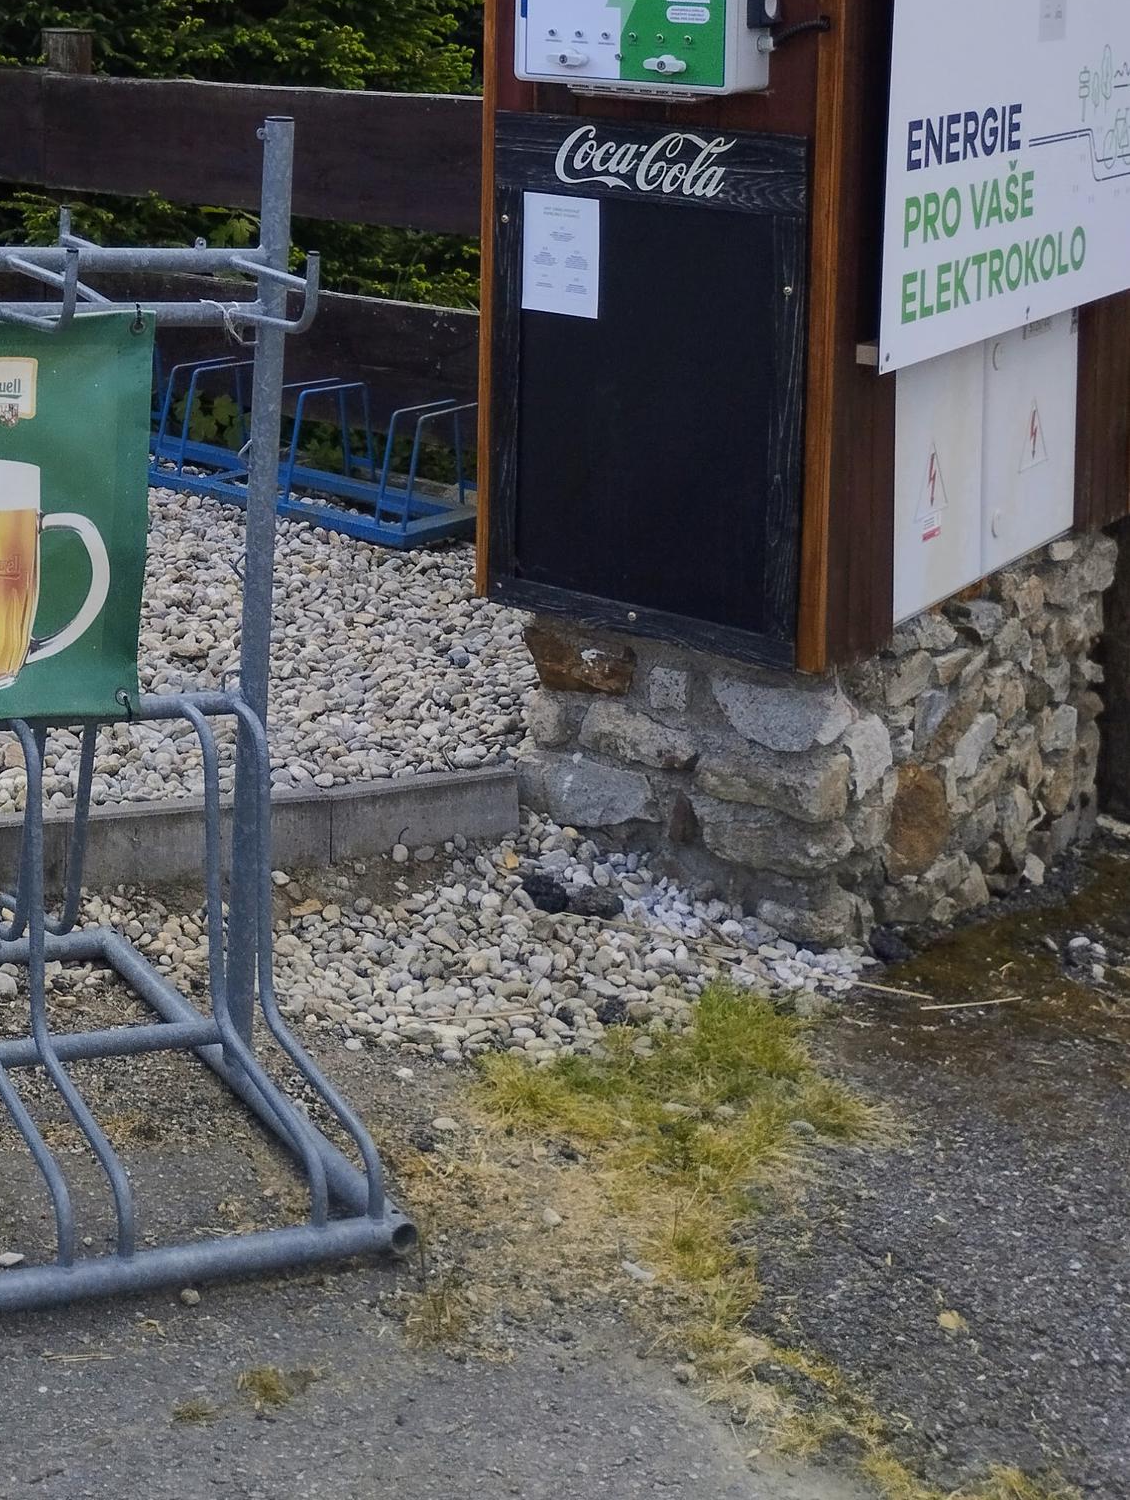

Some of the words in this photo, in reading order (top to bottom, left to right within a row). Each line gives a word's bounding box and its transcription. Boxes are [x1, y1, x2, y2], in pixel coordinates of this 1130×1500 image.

[554, 124, 737, 198] Coca-Cola
[906, 103, 1022, 171] ENERGIE
[903, 186, 961, 248] PRO
[969, 159, 1035, 231] VAŠE
[900, 225, 1086, 325] ELEKTROKOLO
